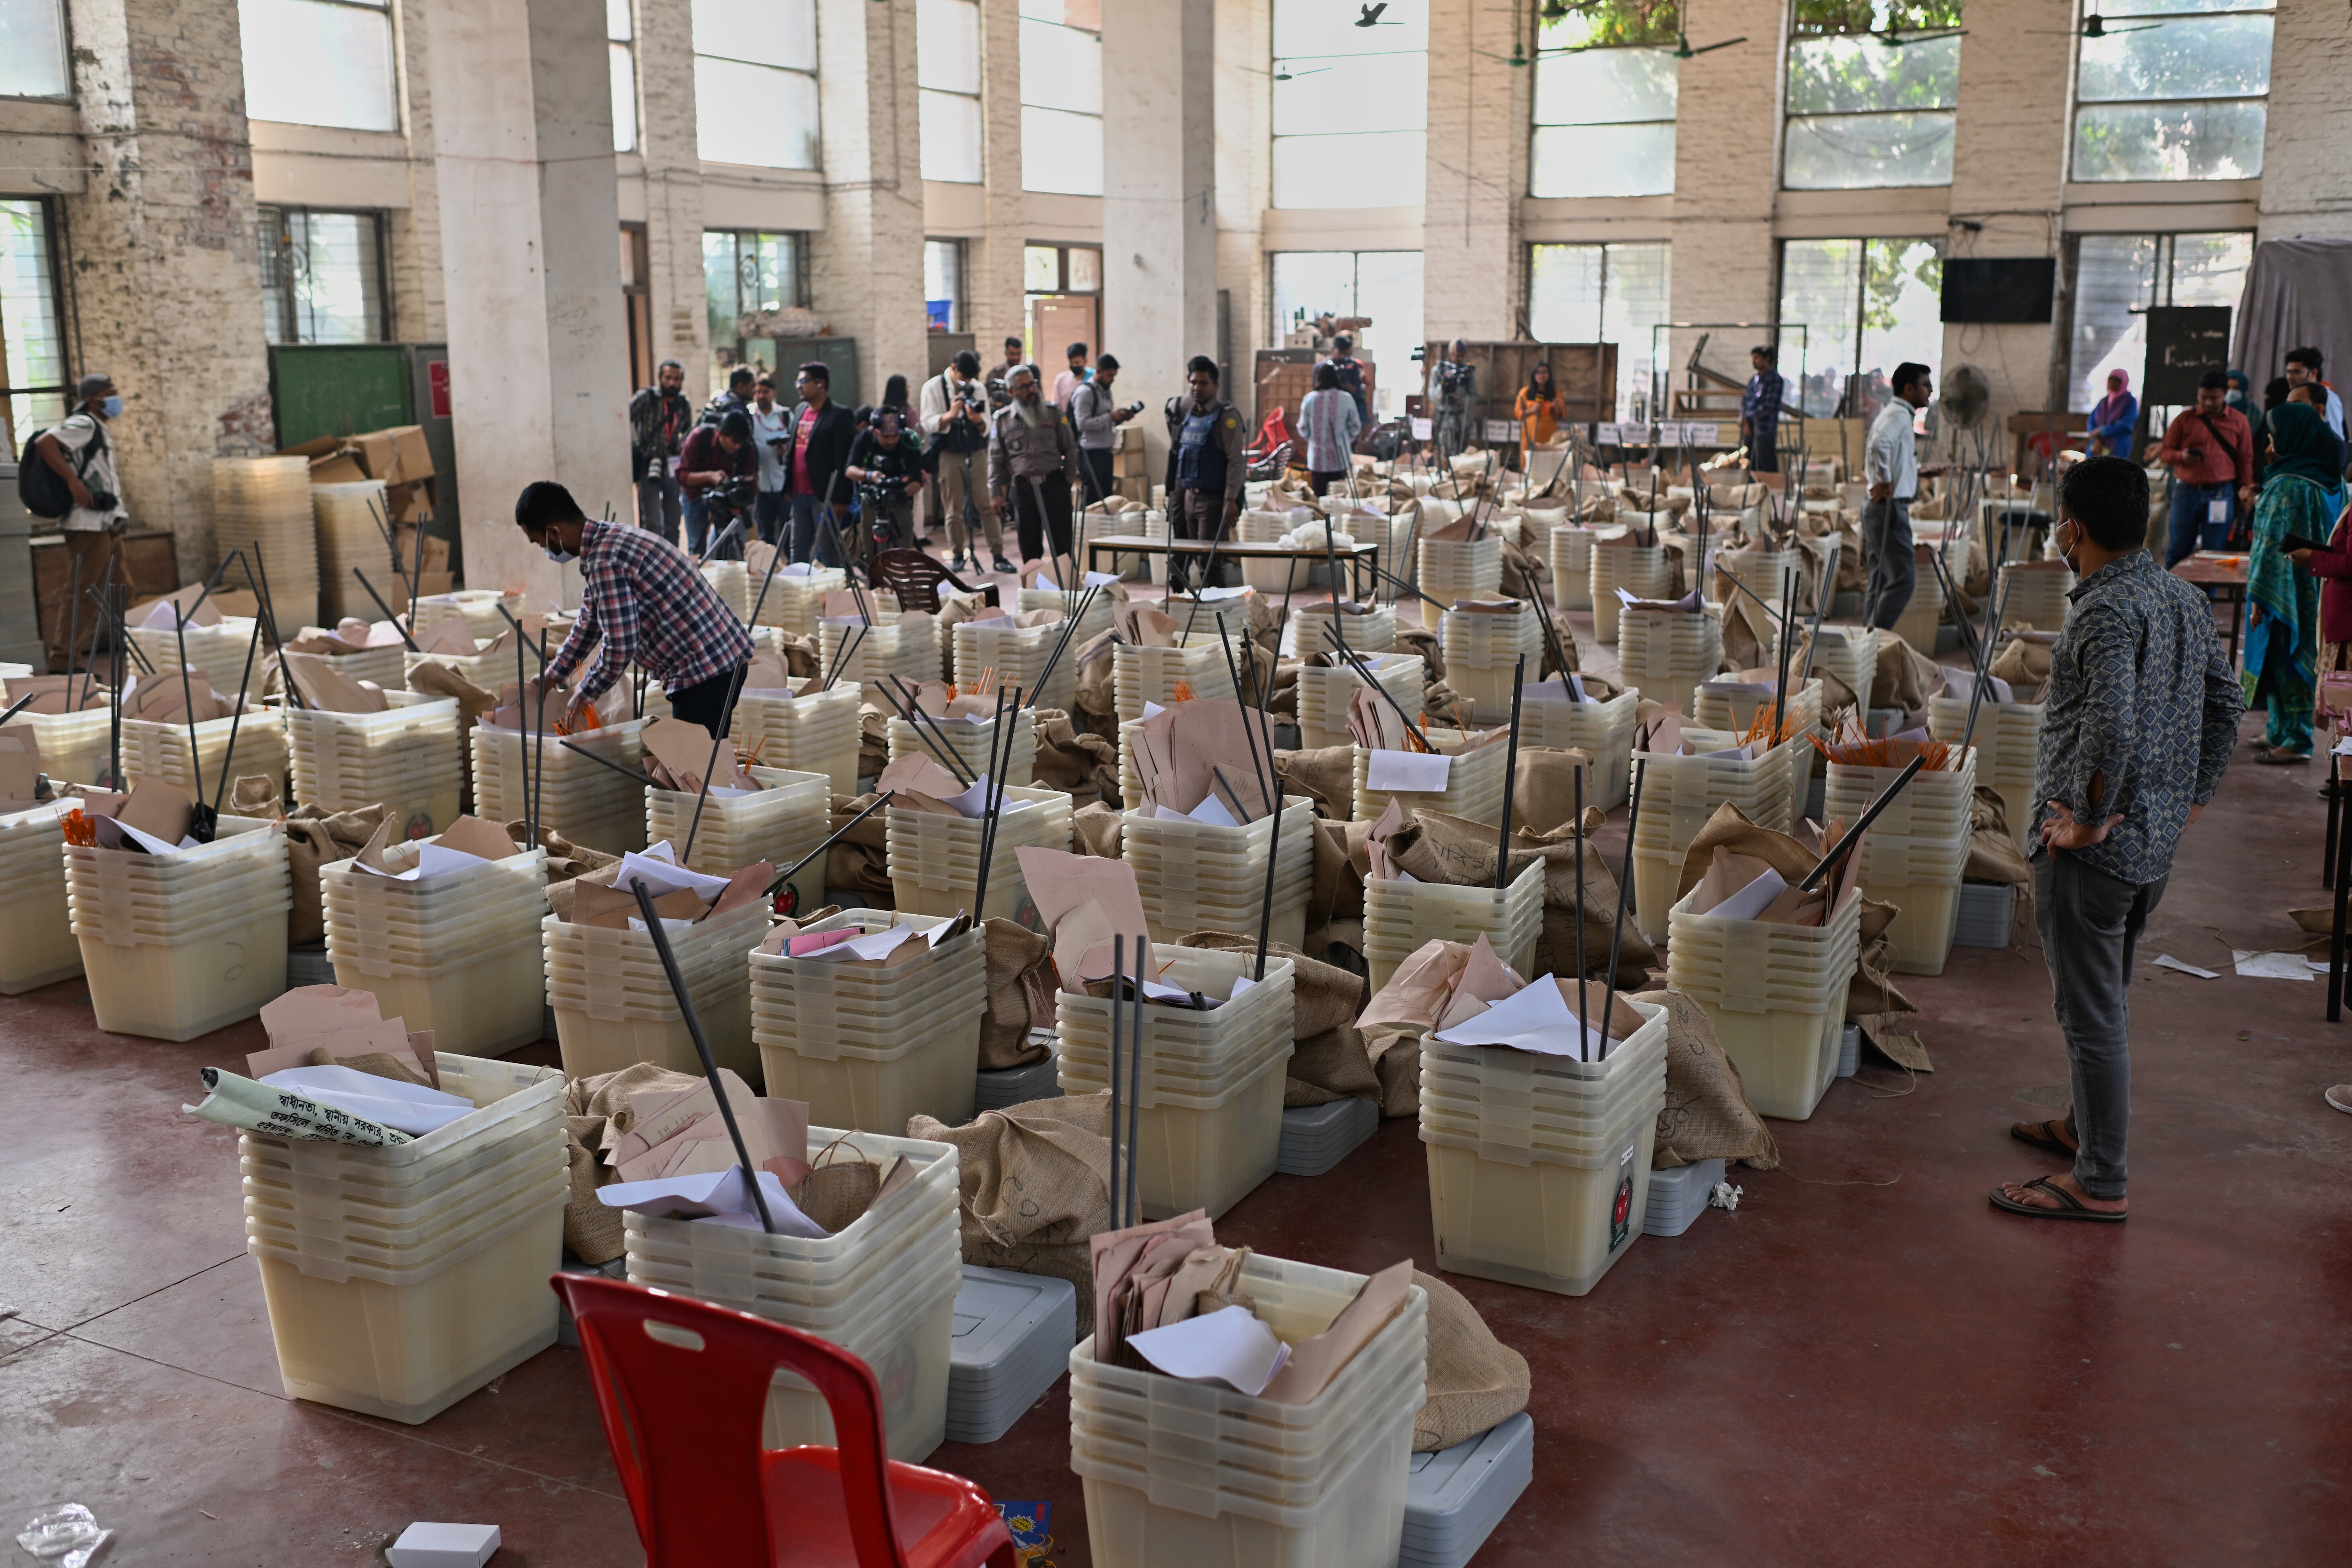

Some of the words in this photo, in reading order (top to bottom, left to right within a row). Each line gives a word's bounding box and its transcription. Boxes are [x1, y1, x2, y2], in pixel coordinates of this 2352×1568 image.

[271, 1111, 311, 1128] তফসিলে
[315, 1123, 341, 1136] বর্ণিত
[279, 1095, 318, 1117] স্বাধীনতা,
[324, 1108, 350, 1125] স্থানীয়
[354, 1118, 384, 1140] সরকার,
[1009, 1520, 1030, 1531] STRONG
[1015, 1518, 1033, 1528] SUPER
